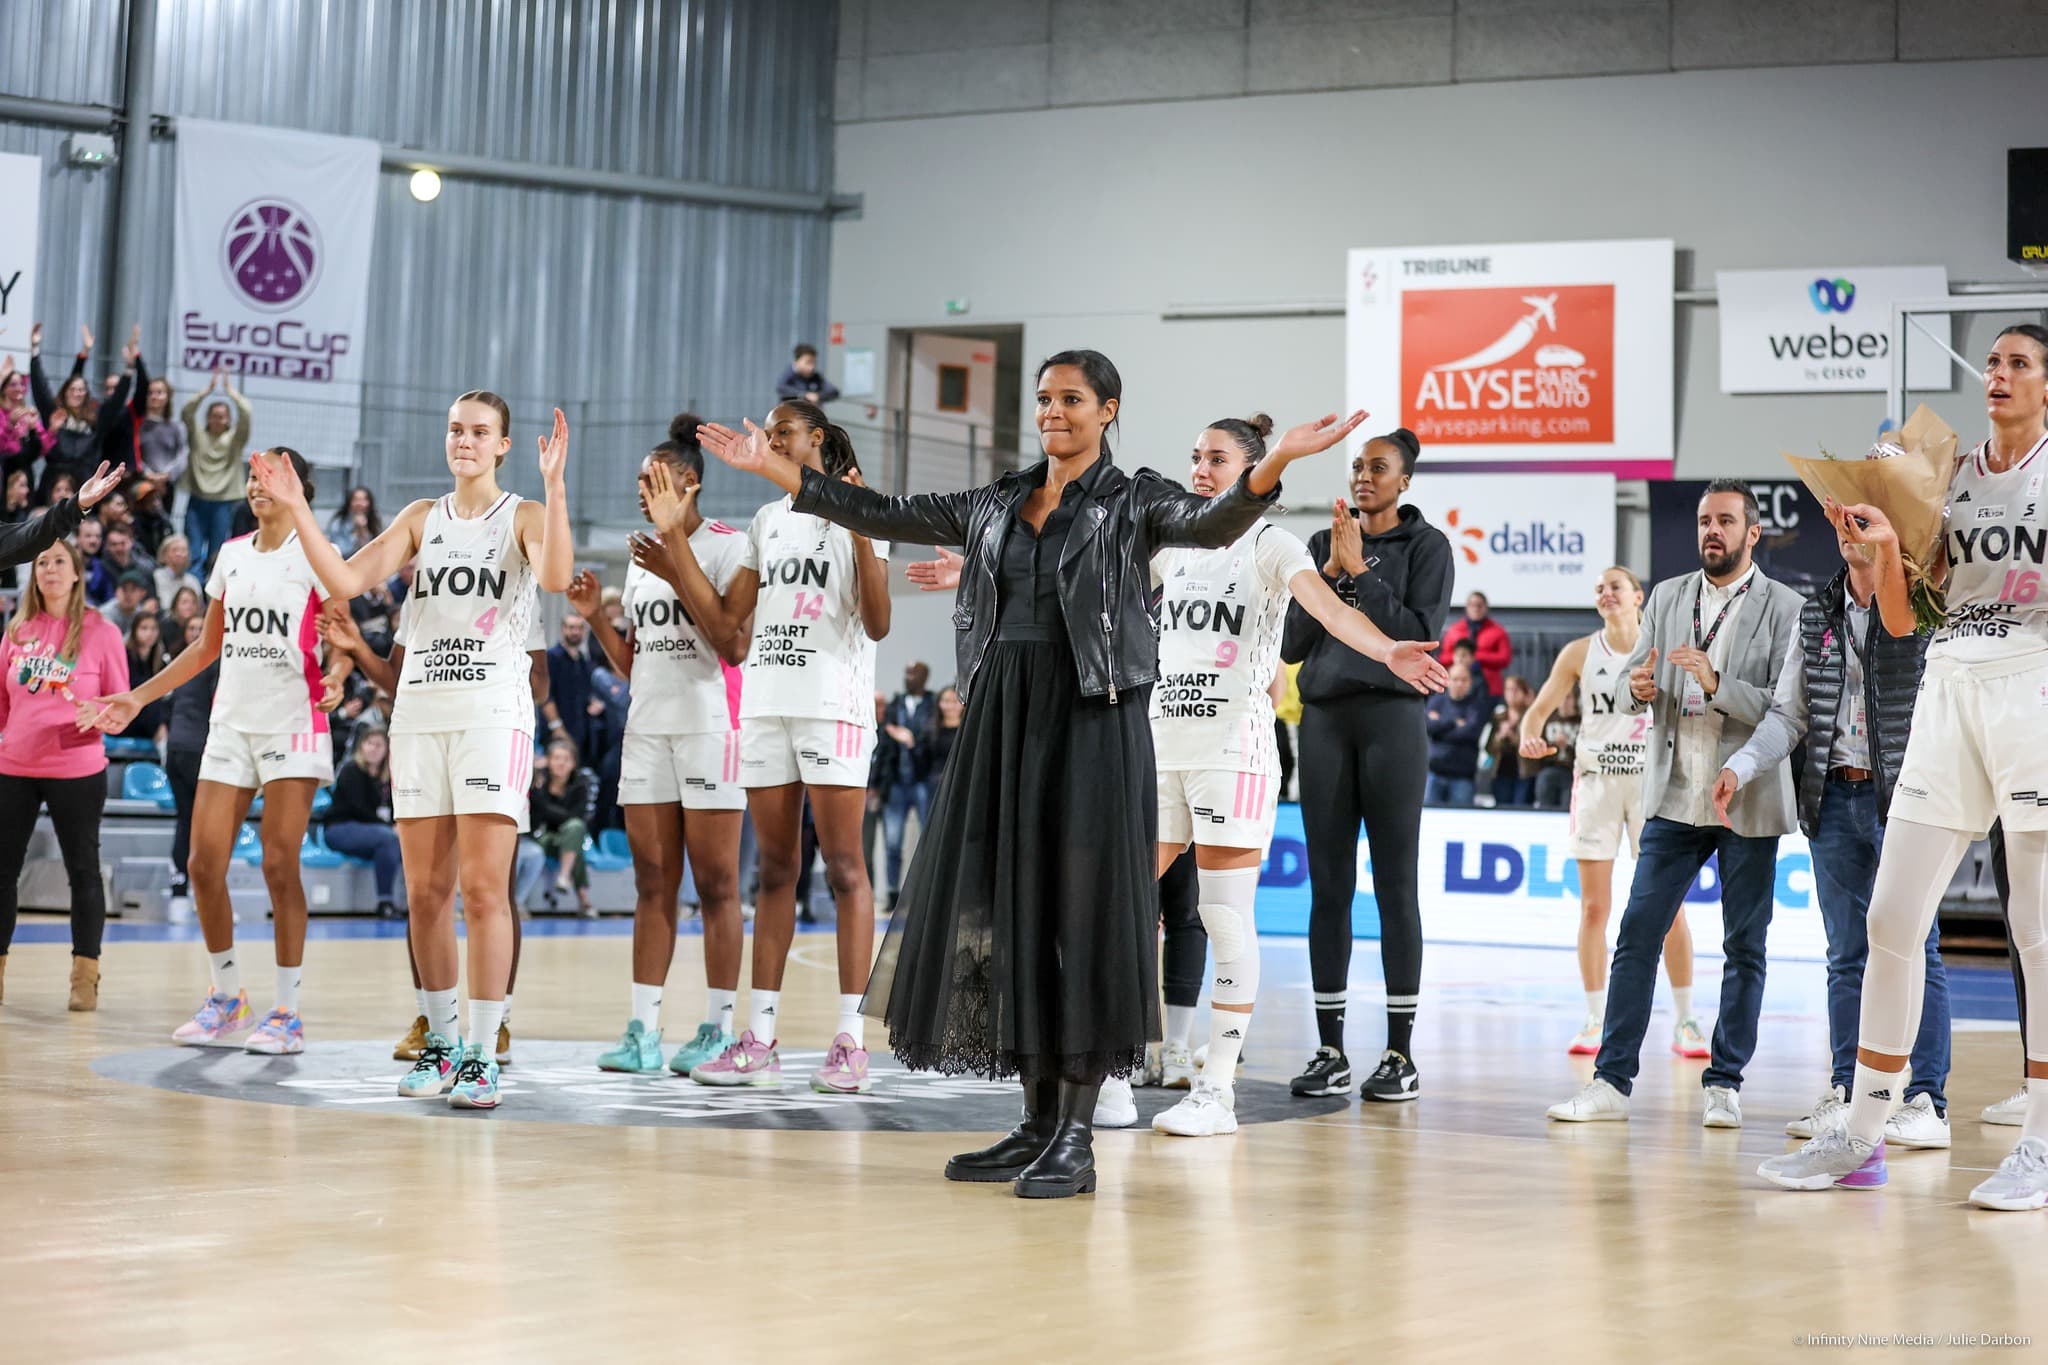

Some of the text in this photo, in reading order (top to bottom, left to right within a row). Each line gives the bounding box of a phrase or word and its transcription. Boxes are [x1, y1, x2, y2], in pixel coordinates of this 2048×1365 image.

[1402, 257, 1492, 275] TRIBUNE
[184, 312, 349, 356] EuroCup
[184, 350, 331, 381] women
[1415, 369, 1534, 411] ALYSE
[1536, 390, 1590, 409] AUTO
[1416, 414, 1591, 438] alyseparking.com
[1752, 485, 1799, 528] EC
[1489, 522, 1584, 554] dalkia
[1946, 526, 2048, 568] LYON
[414, 566, 506, 600] LYON
[1998, 569, 2041, 604] 16
[792, 592, 824, 621] 14
[474, 606, 500, 636] 4
[1164, 600, 1246, 636] YON
[764, 625, 809, 638] SMART
[237, 643, 288, 659] webex
[431, 638, 485, 652] SMART
[645, 635, 696, 652] webex
[759, 639, 793, 651] GOOD
[424, 654, 470, 668] GOOD
[759, 654, 807, 667] THINGS
[1215, 640, 1239, 668] 9
[424, 668, 487, 682] THINGS
[1166, 673, 1219, 687] SMART
[1160, 688, 1202, 701] GOOD
[1592, 692, 1615, 714] LY
[1161, 703, 1217, 717] THINGS
[1598, 754, 1636, 765] GOOD
